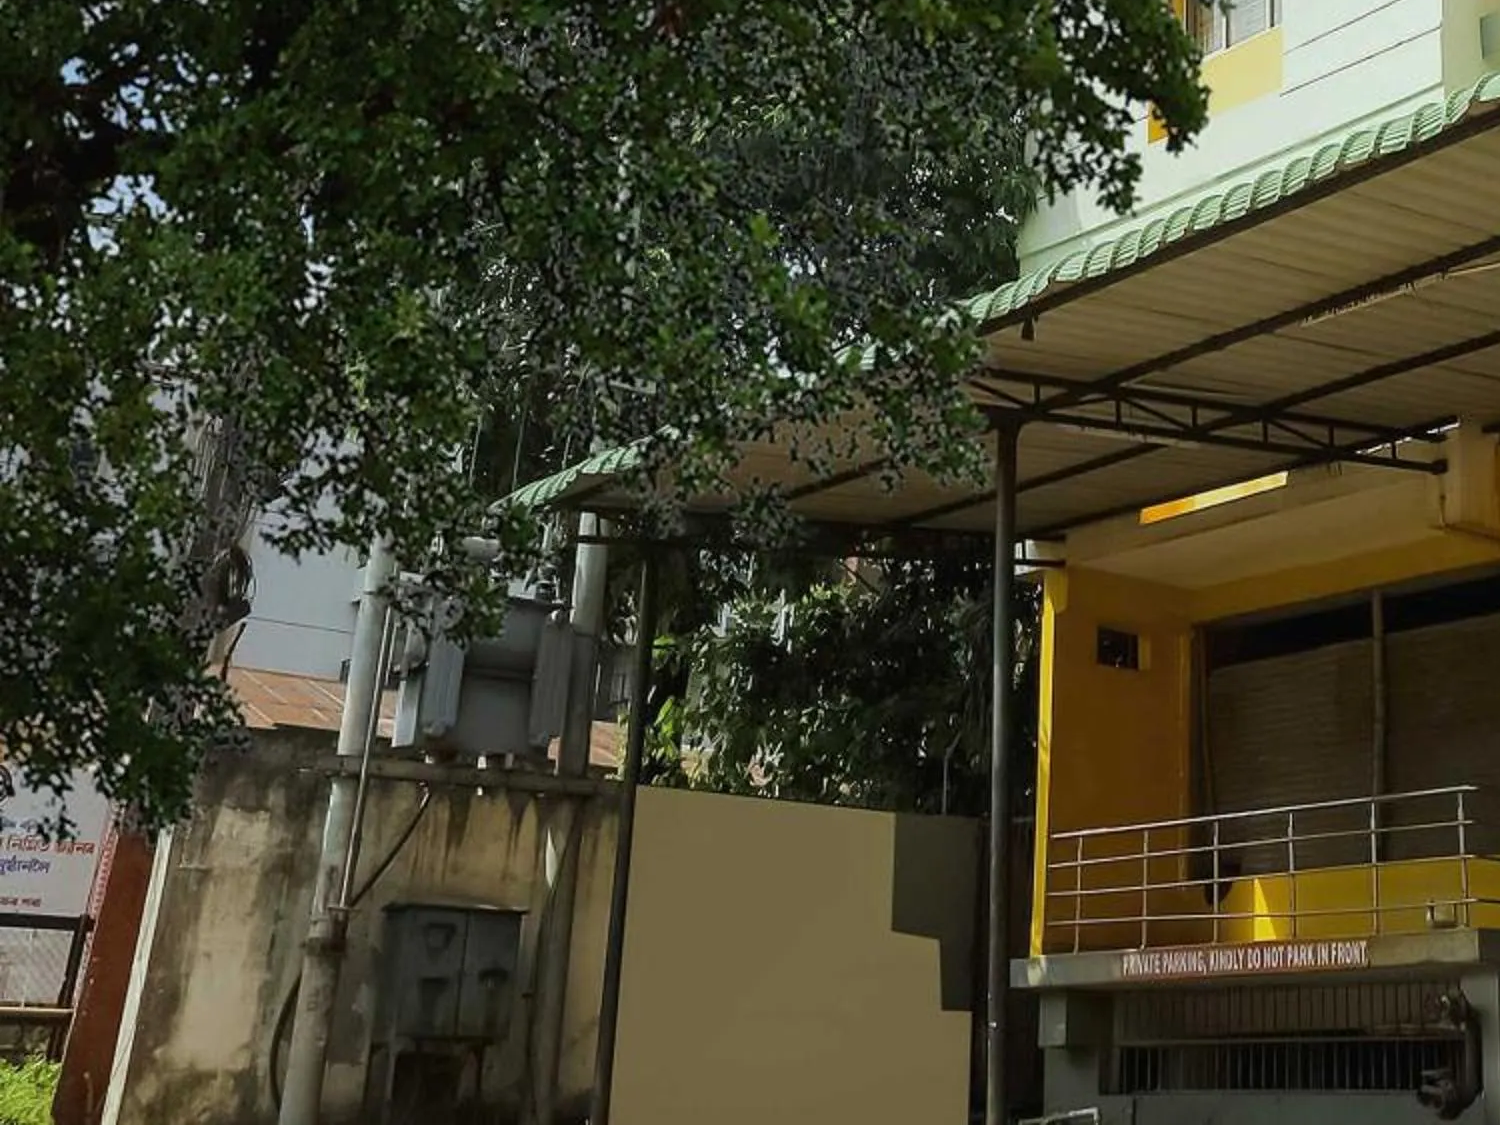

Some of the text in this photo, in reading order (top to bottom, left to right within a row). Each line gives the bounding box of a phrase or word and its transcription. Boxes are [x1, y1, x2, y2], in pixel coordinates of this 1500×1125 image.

[1123, 951, 1161, 975] PRIVATE
[1209, 947, 1244, 971] KINDLY
[1246, 945, 1261, 970] DO
[1263, 944, 1285, 969] NOT
[1287, 942, 1315, 968] PARK
[1316, 941, 1329, 966] IN
